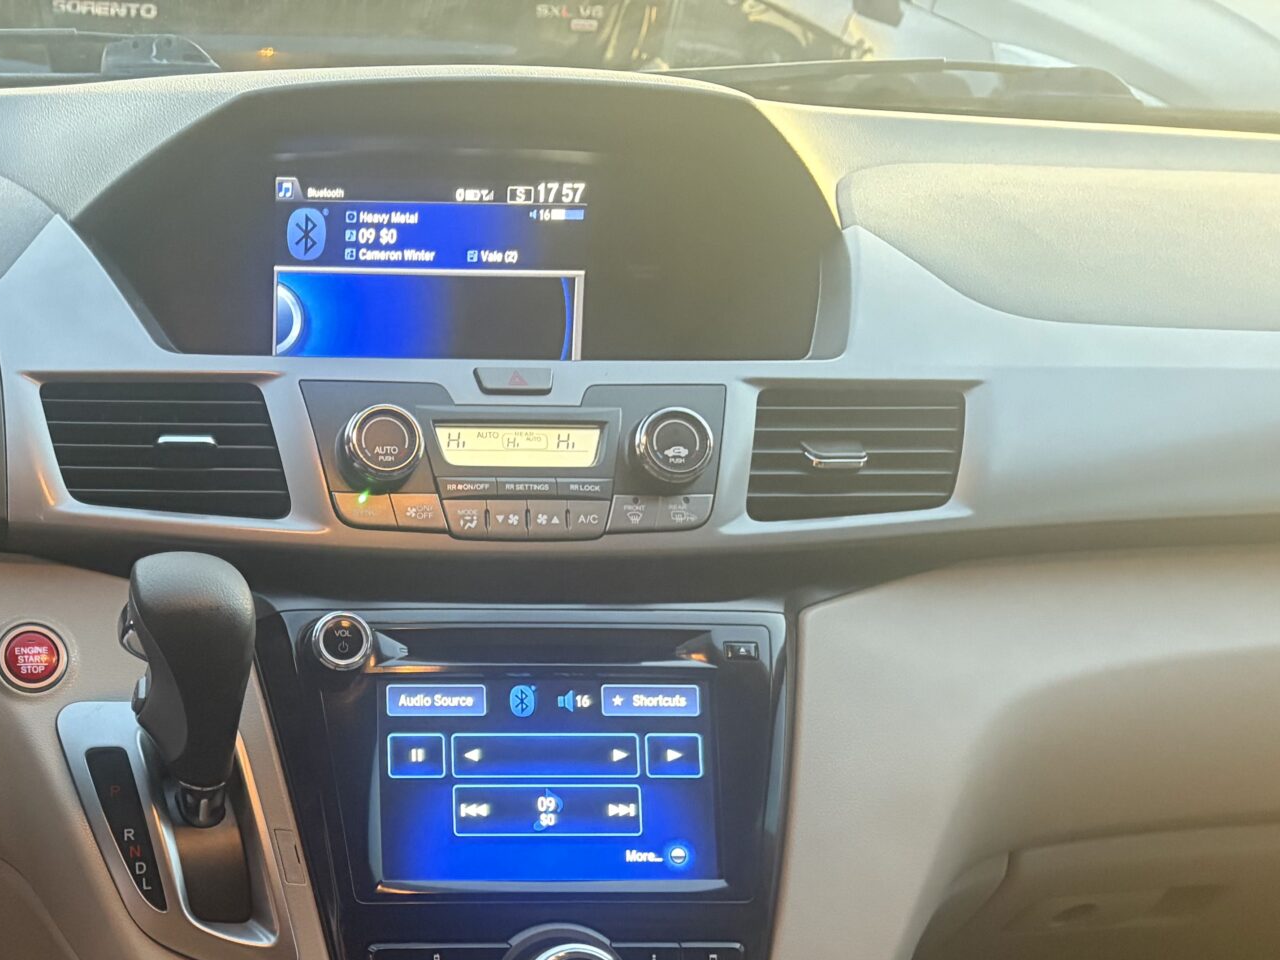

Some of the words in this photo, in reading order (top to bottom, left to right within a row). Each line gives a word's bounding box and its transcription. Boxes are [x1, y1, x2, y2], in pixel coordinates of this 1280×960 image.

[307, 187, 344, 198] Bluetooth
[359, 211, 389, 224] Heavy
[391, 211, 419, 224] Metal
[539, 209, 551, 221] 16
[358, 228, 376, 244] 09
[359, 248, 402, 261] Cameron
[403, 249, 436, 262] Winter
[374, 446, 399, 454] AUTO
[578, 514, 599, 523] A/C
[334, 629, 352, 638] VOL
[15, 646, 49, 655] ENGINE
[17, 654, 47, 664] START
[20, 665, 46, 674] STOP
[398, 694, 431, 707] Audio
[433, 694, 474, 707] Source
[576, 694, 591, 708] 16
[632, 694, 687, 708] Shortcuts
[110, 785, 120, 797] P
[537, 796, 556, 812] 09
[123, 828, 135, 841] R
[129, 845, 141, 857] N
[135, 863, 147, 874] D
[142, 878, 152, 890] L
